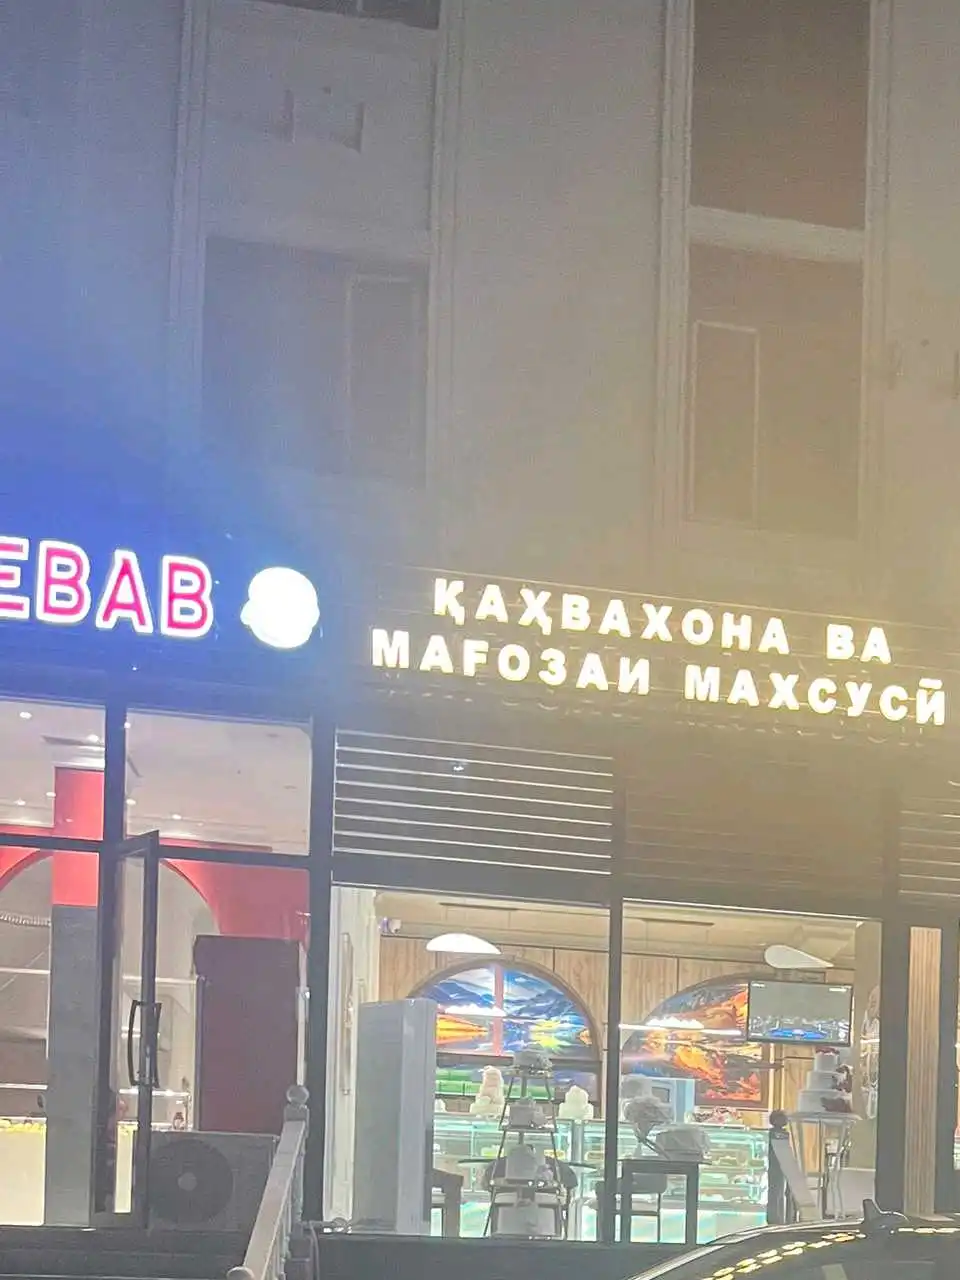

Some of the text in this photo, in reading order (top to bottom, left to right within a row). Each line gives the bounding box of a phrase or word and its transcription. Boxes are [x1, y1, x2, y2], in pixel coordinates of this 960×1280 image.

[433, 578, 892, 665] ҚАҲВАХОНА ВА
[371, 628, 650, 696] МАҒОЗАИ
